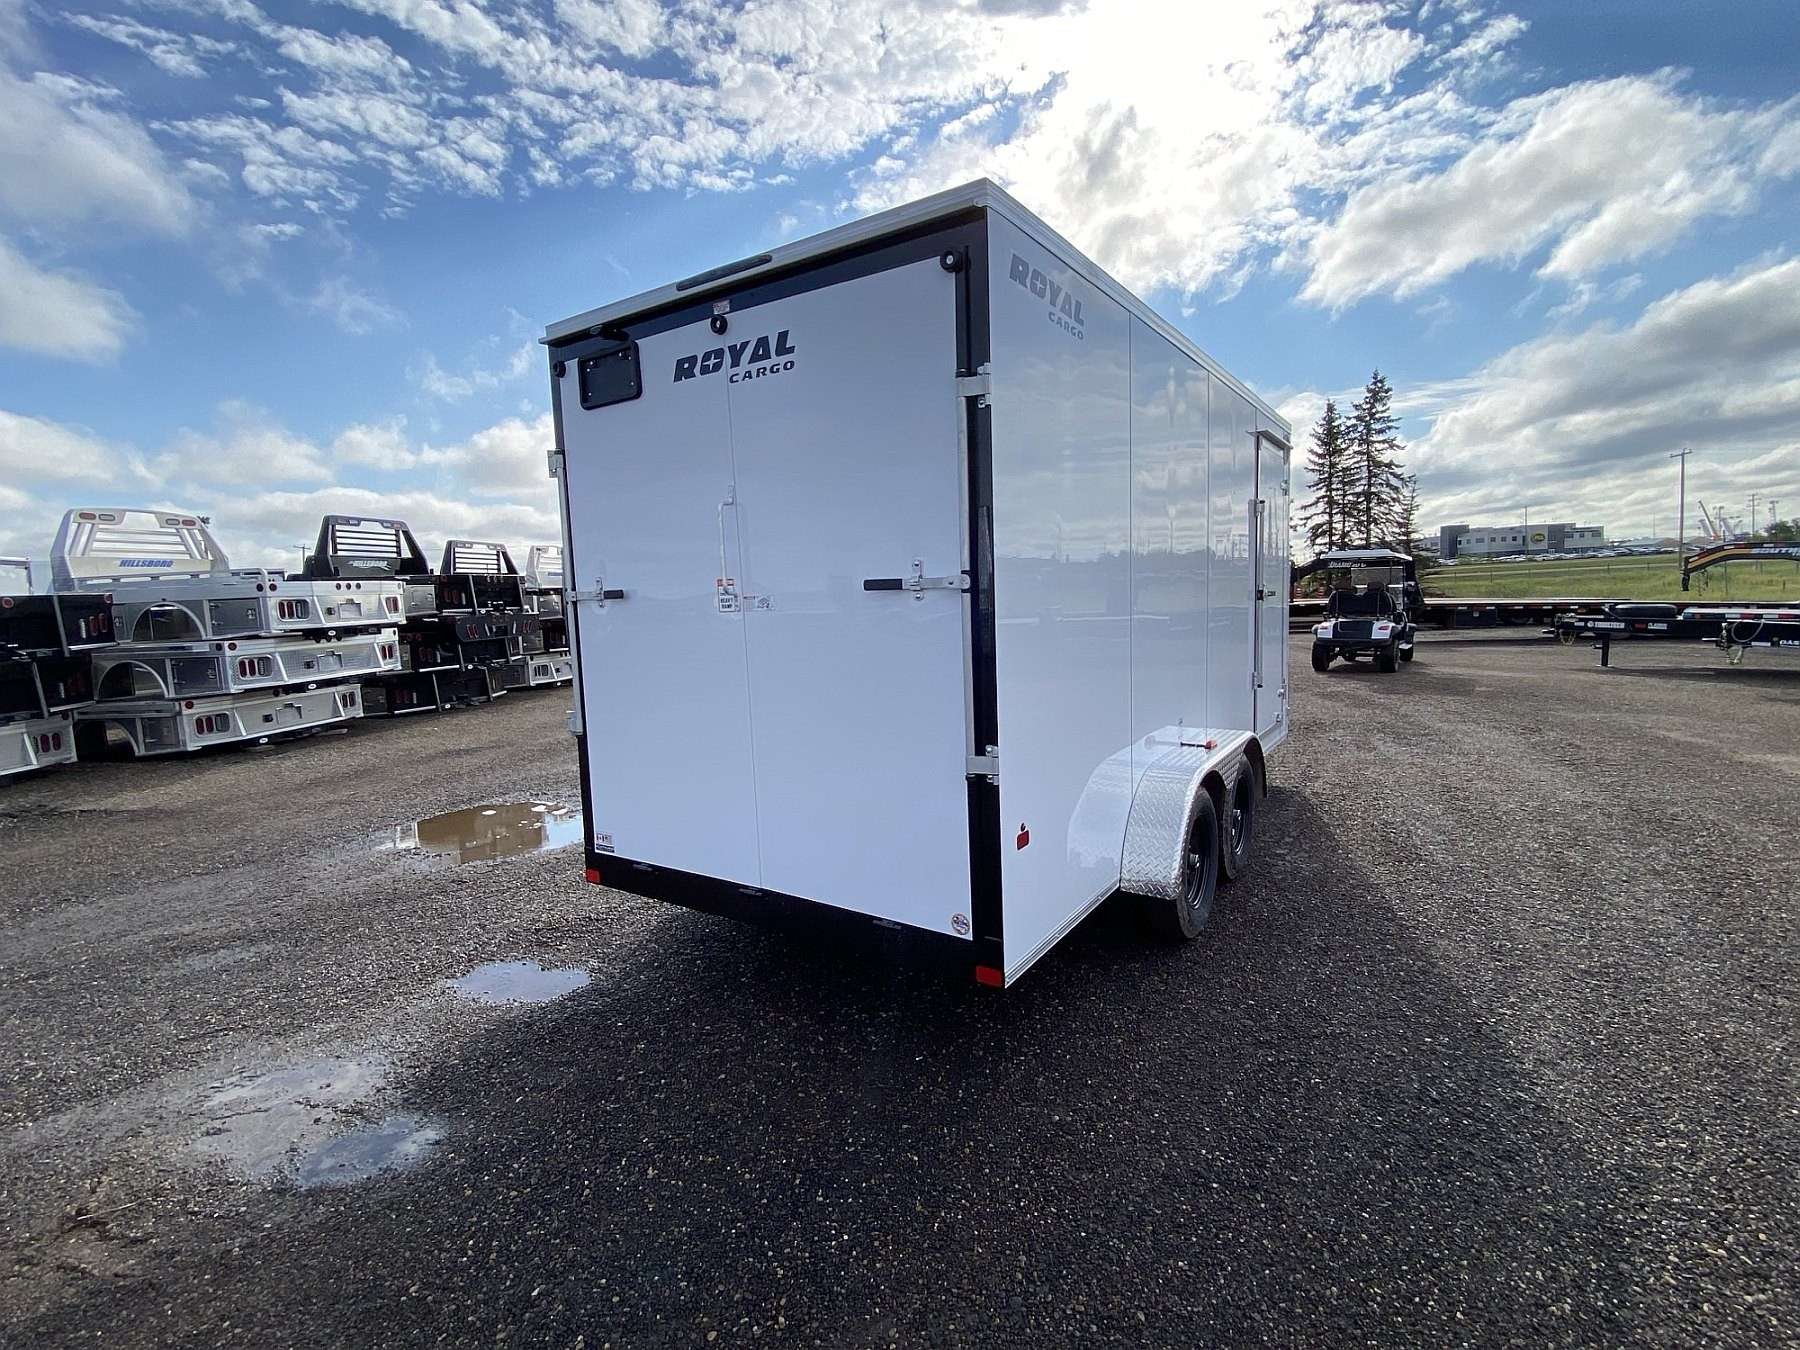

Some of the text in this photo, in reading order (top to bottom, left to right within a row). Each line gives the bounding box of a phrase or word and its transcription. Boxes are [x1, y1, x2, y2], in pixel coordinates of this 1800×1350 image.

[1009, 253, 1085, 328] ROYAL
[1048, 310, 1085, 341] CARGO
[673, 329, 797, 384] ROYAL
[728, 360, 796, 385] CARGO
[119, 559, 174, 569] HILLSBORO
